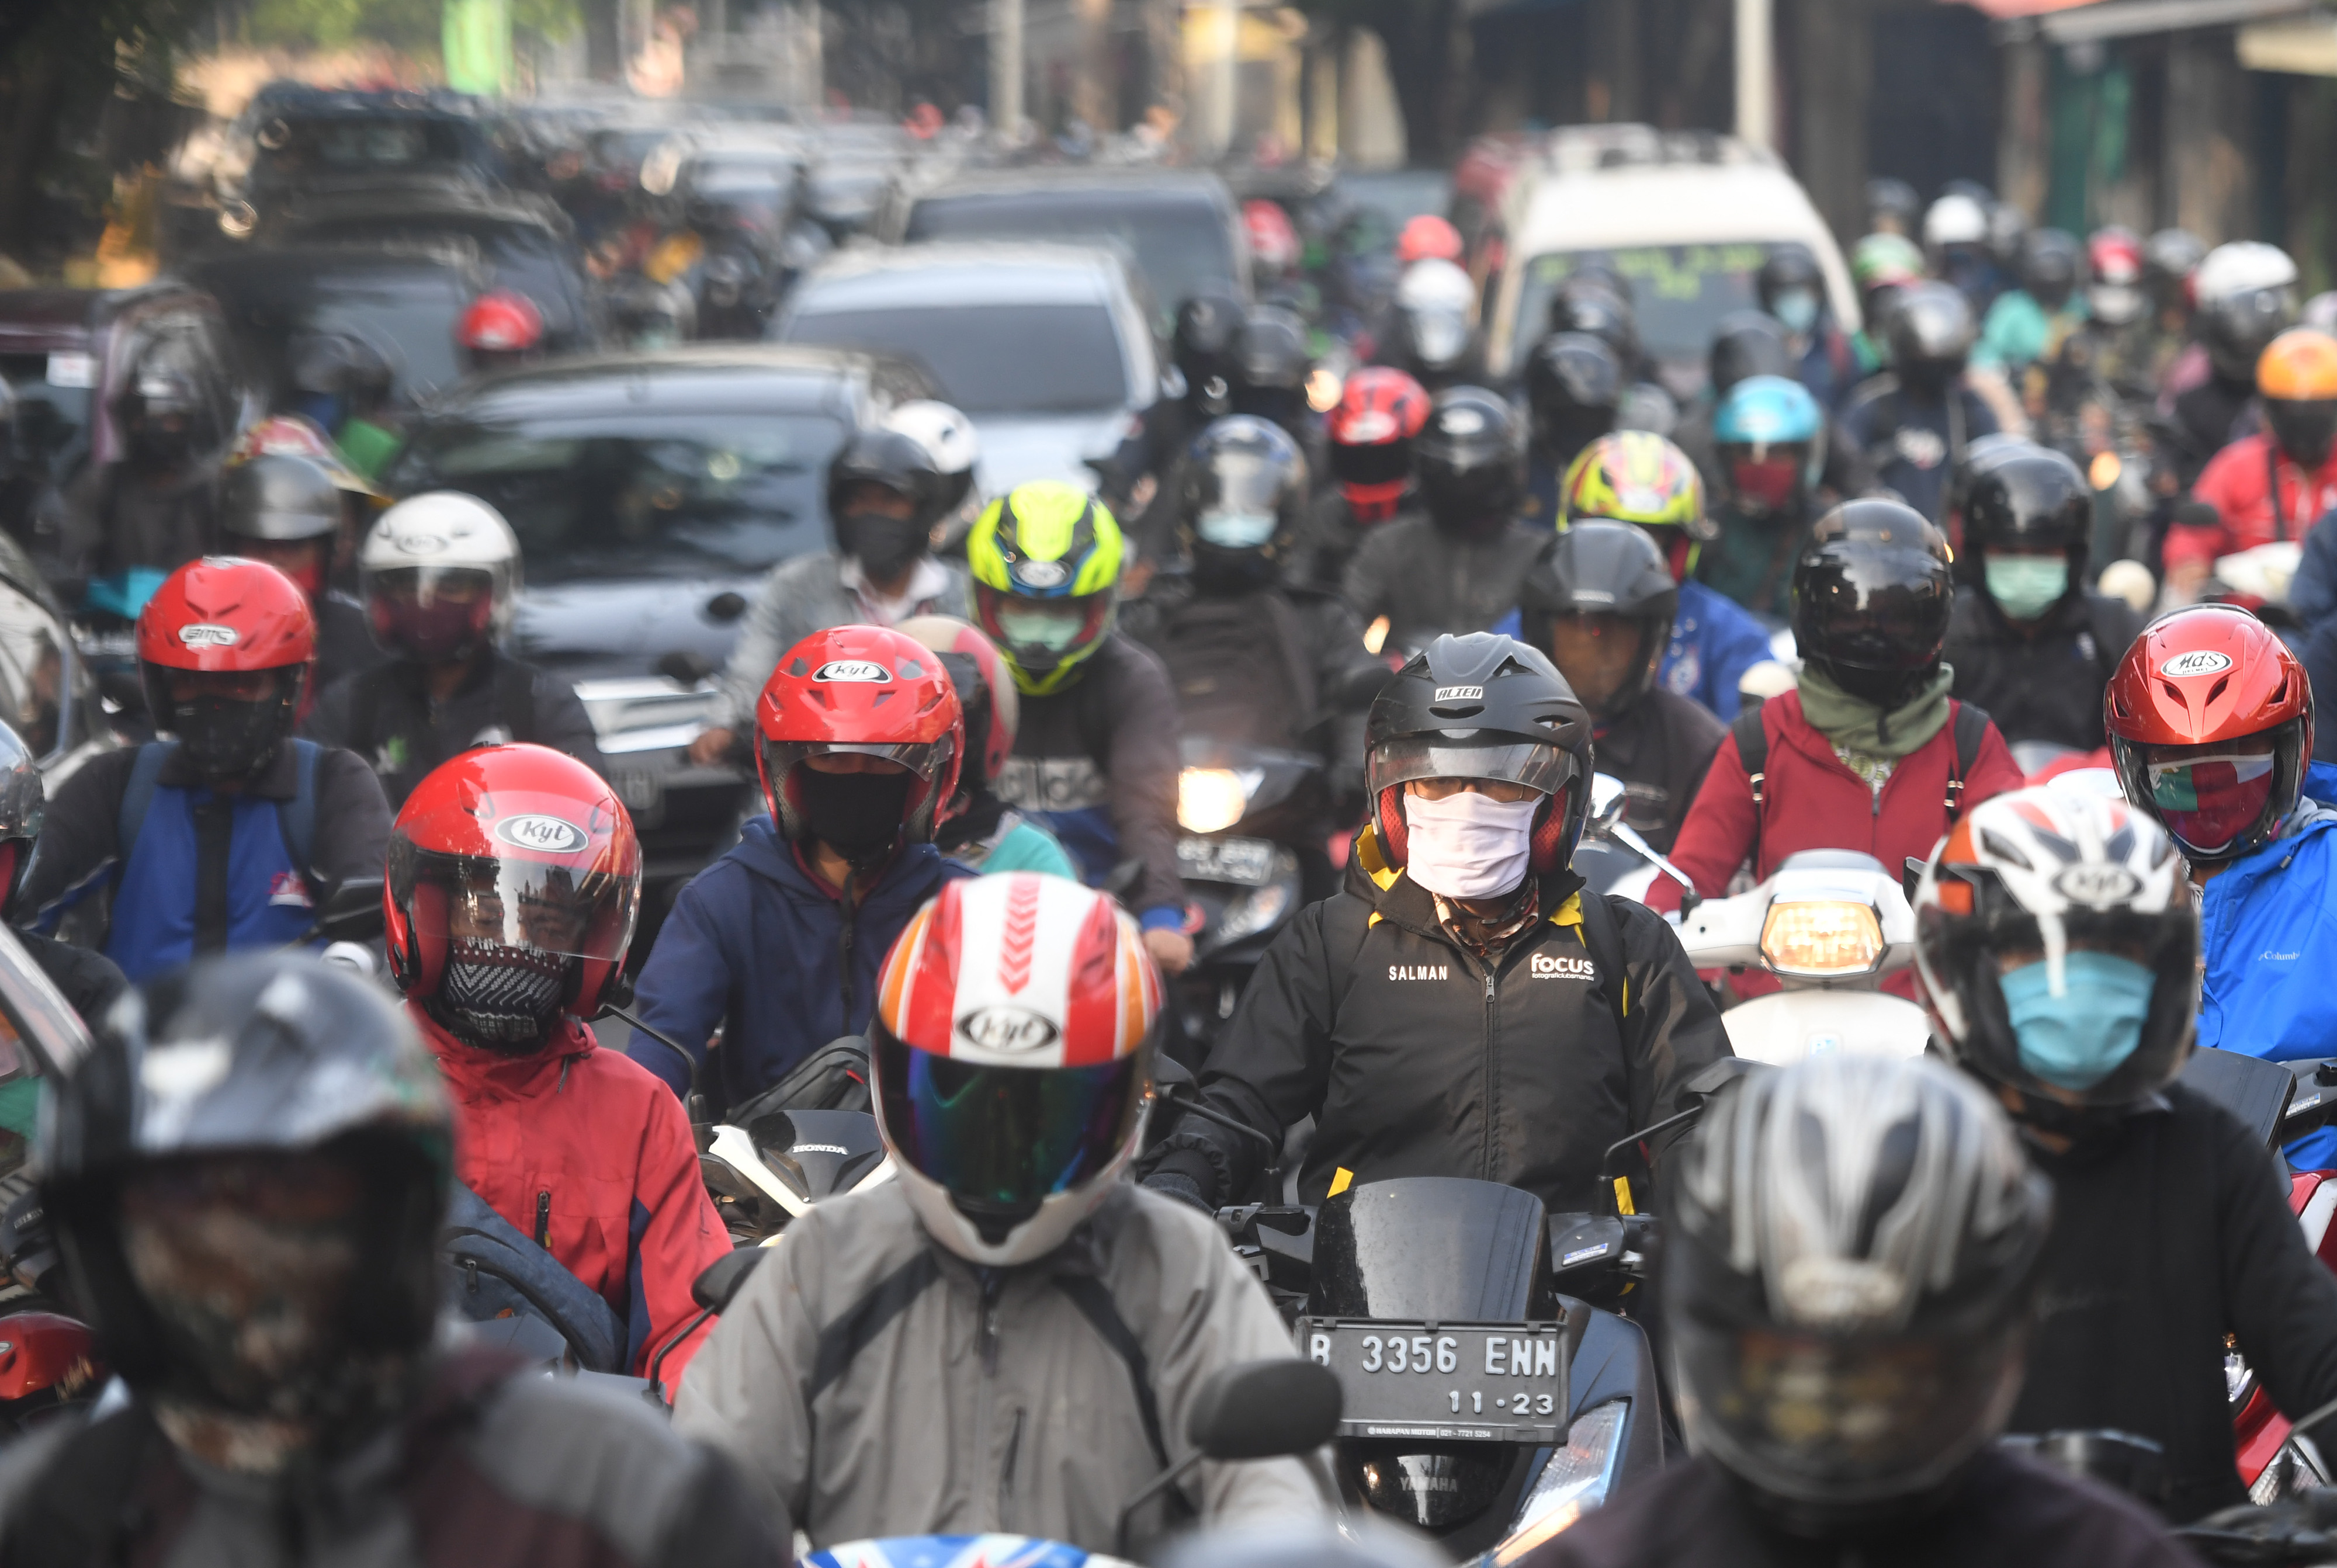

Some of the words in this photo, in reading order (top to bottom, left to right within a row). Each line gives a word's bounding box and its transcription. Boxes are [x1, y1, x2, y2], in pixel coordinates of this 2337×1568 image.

[2264, 950, 2300, 960] Columb
[1389, 966, 1448, 981] SALMAN
[792, 1144, 849, 1156] HONDA
[1310, 1334, 1330, 1367] B
[1362, 1335, 1457, 1373] 3356
[1485, 1337, 1556, 1376] ENN
